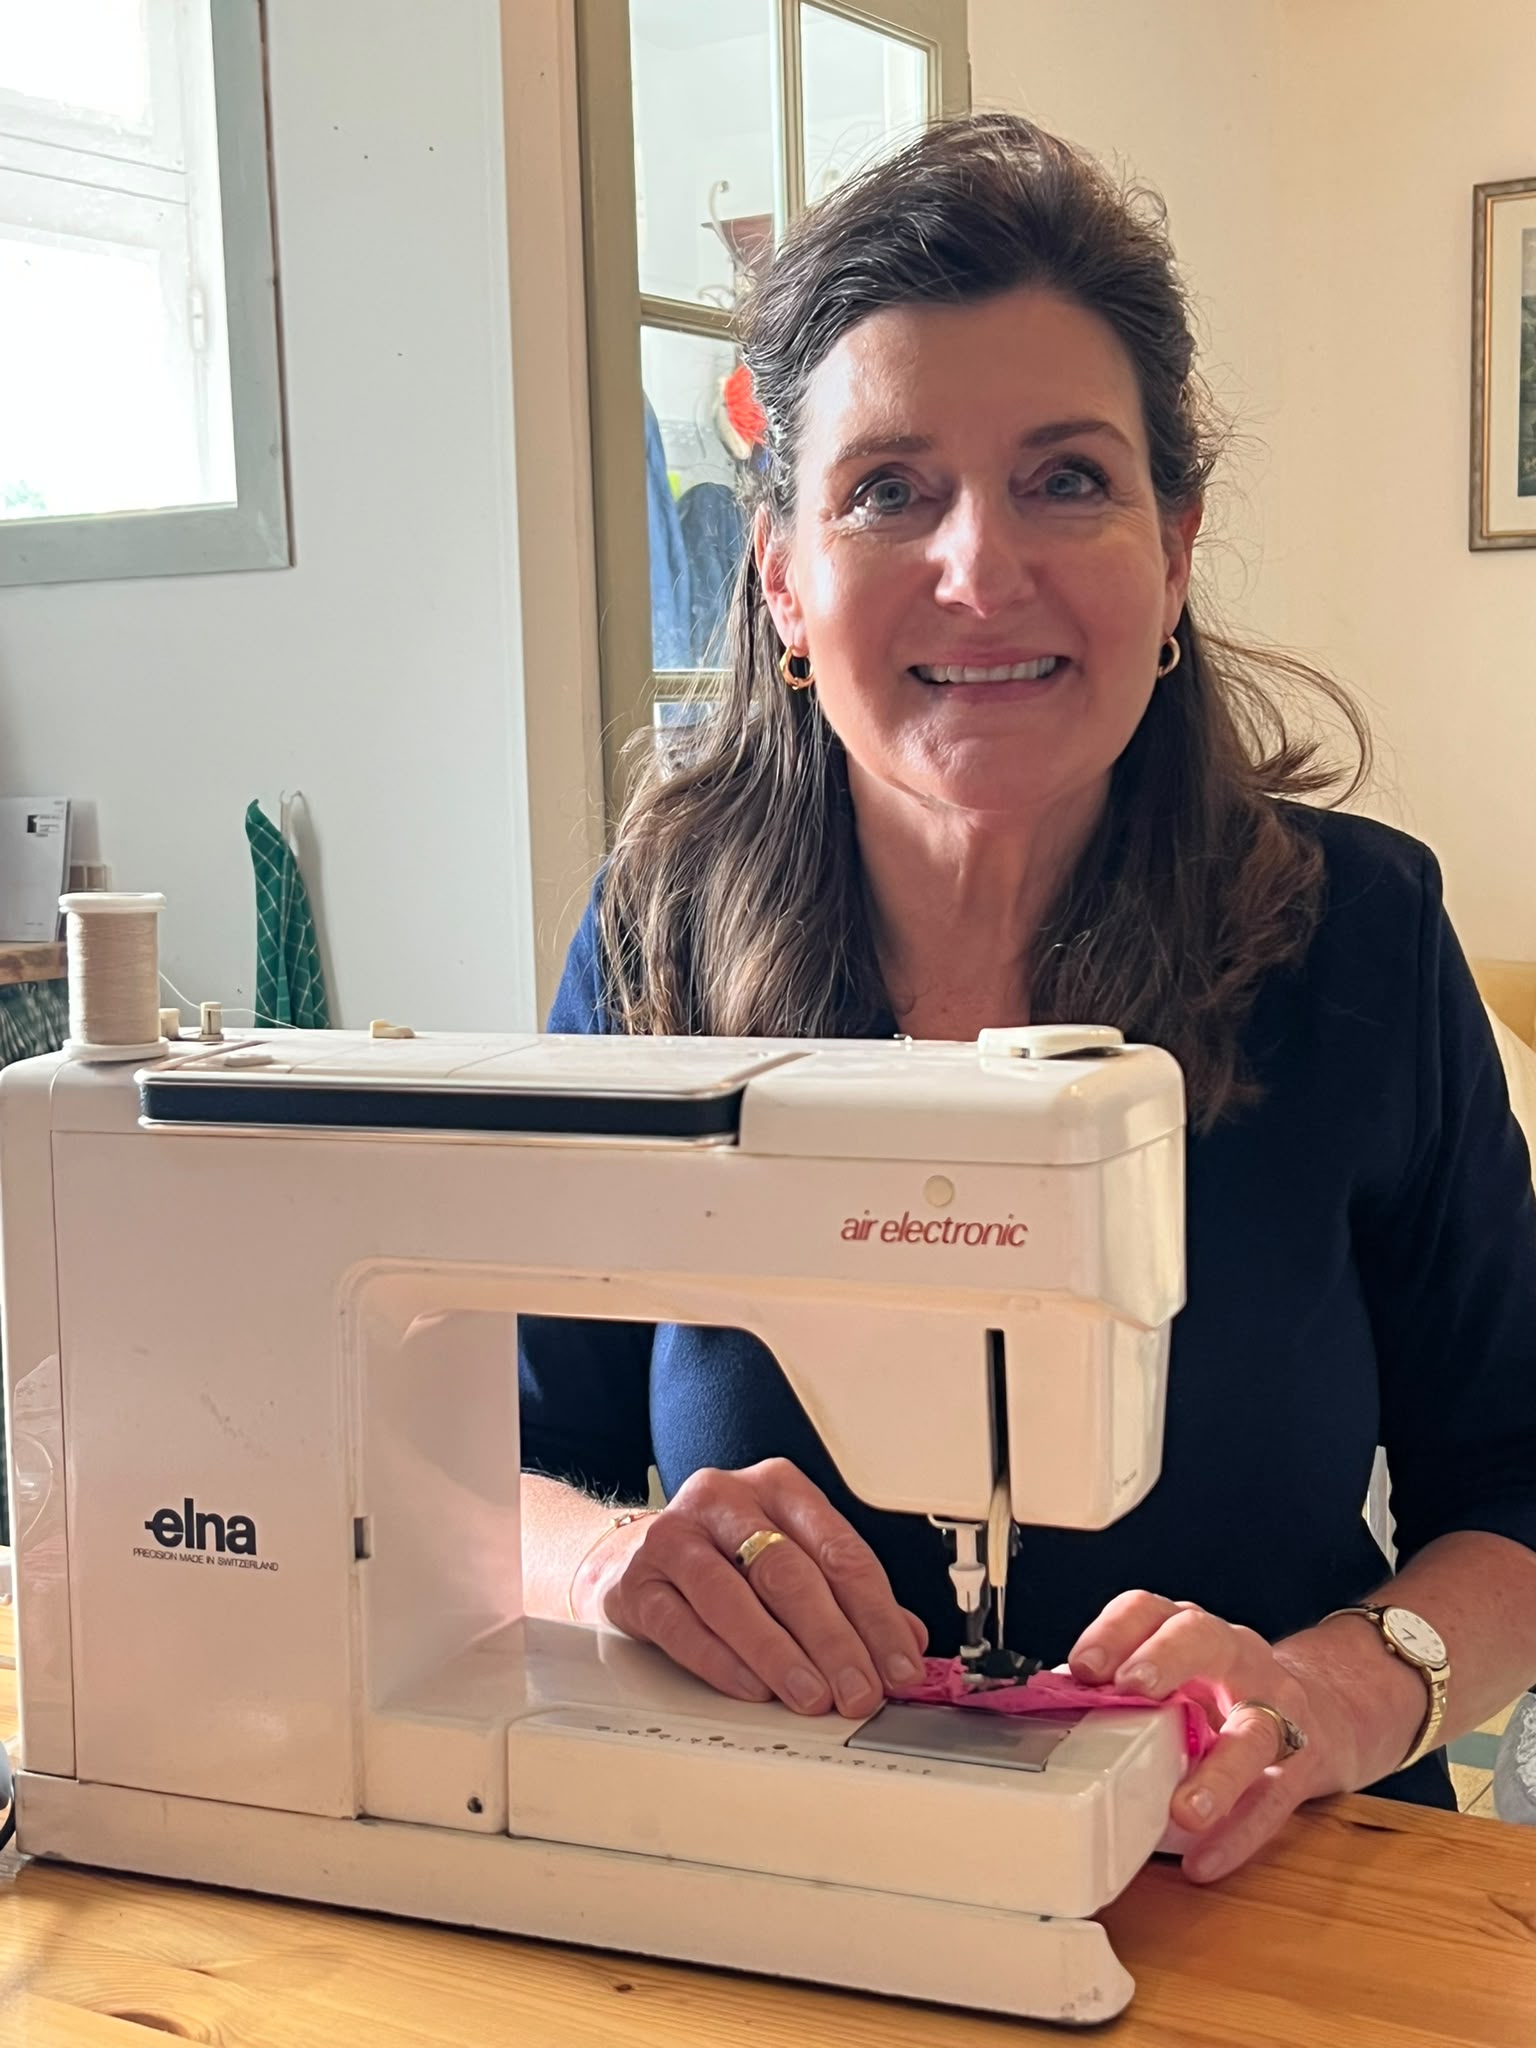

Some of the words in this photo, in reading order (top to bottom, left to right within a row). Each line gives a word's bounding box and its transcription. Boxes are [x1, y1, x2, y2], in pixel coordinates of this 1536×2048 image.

[841, 1209, 879, 1241] air
[880, 1211, 1029, 1247] electronic
[144, 1497, 257, 1556] elna
[133, 1547, 177, 1561] PRECISION
[179, 1552, 205, 1564] MADE
[206, 1555, 215, 1565] IN
[217, 1556, 279, 1572] SWITZERLAND
